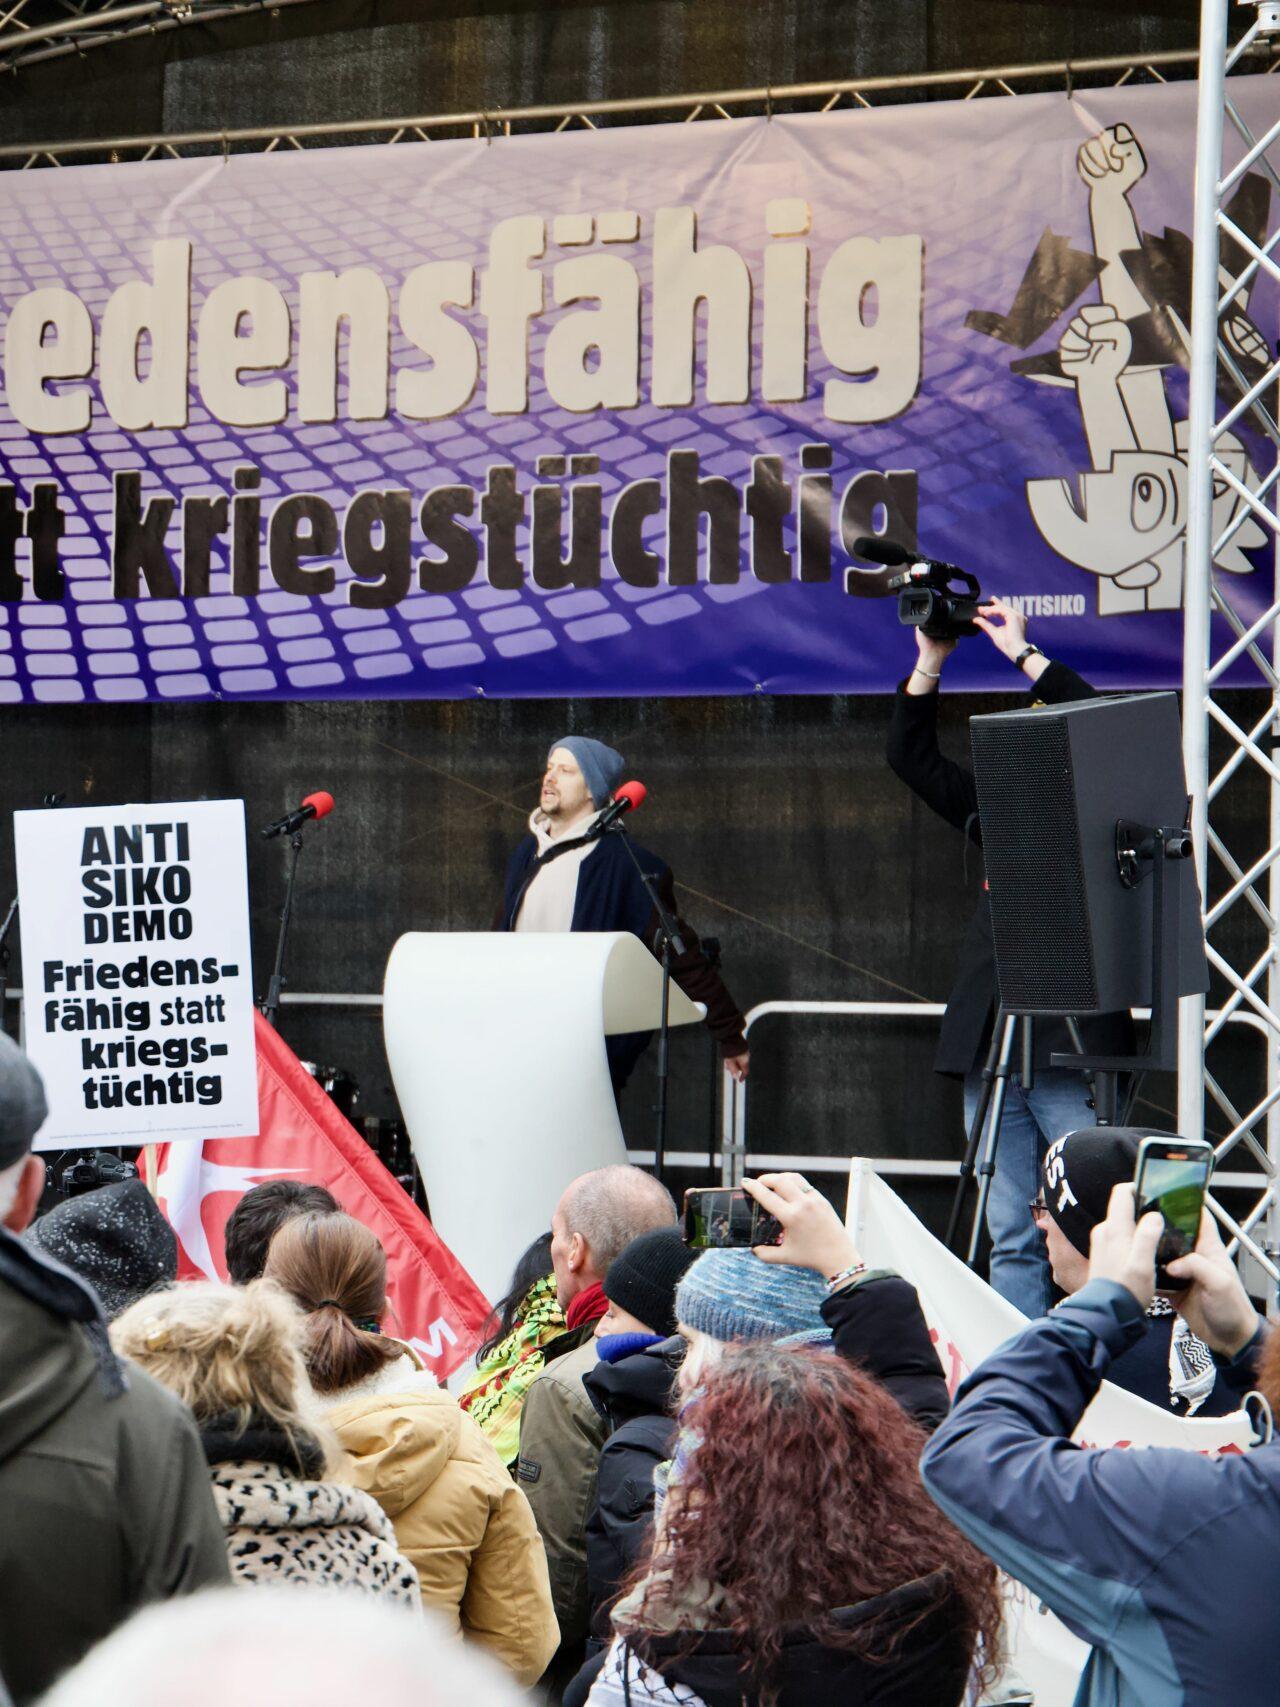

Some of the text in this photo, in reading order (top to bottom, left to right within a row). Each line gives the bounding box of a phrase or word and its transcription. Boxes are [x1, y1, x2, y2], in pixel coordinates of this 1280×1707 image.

[112, 443, 919, 610] kriegstüchtig
[80, 822, 190, 867] ANTI
[81, 865, 191, 909] SIKO
[83, 908, 193, 944] DEMO
[42, 956, 239, 993] Friedens-
[43, 994, 226, 1033] fähig statt
[81, 1035, 228, 1070] kriegs-
[82, 1071, 223, 1110] tüchtig
